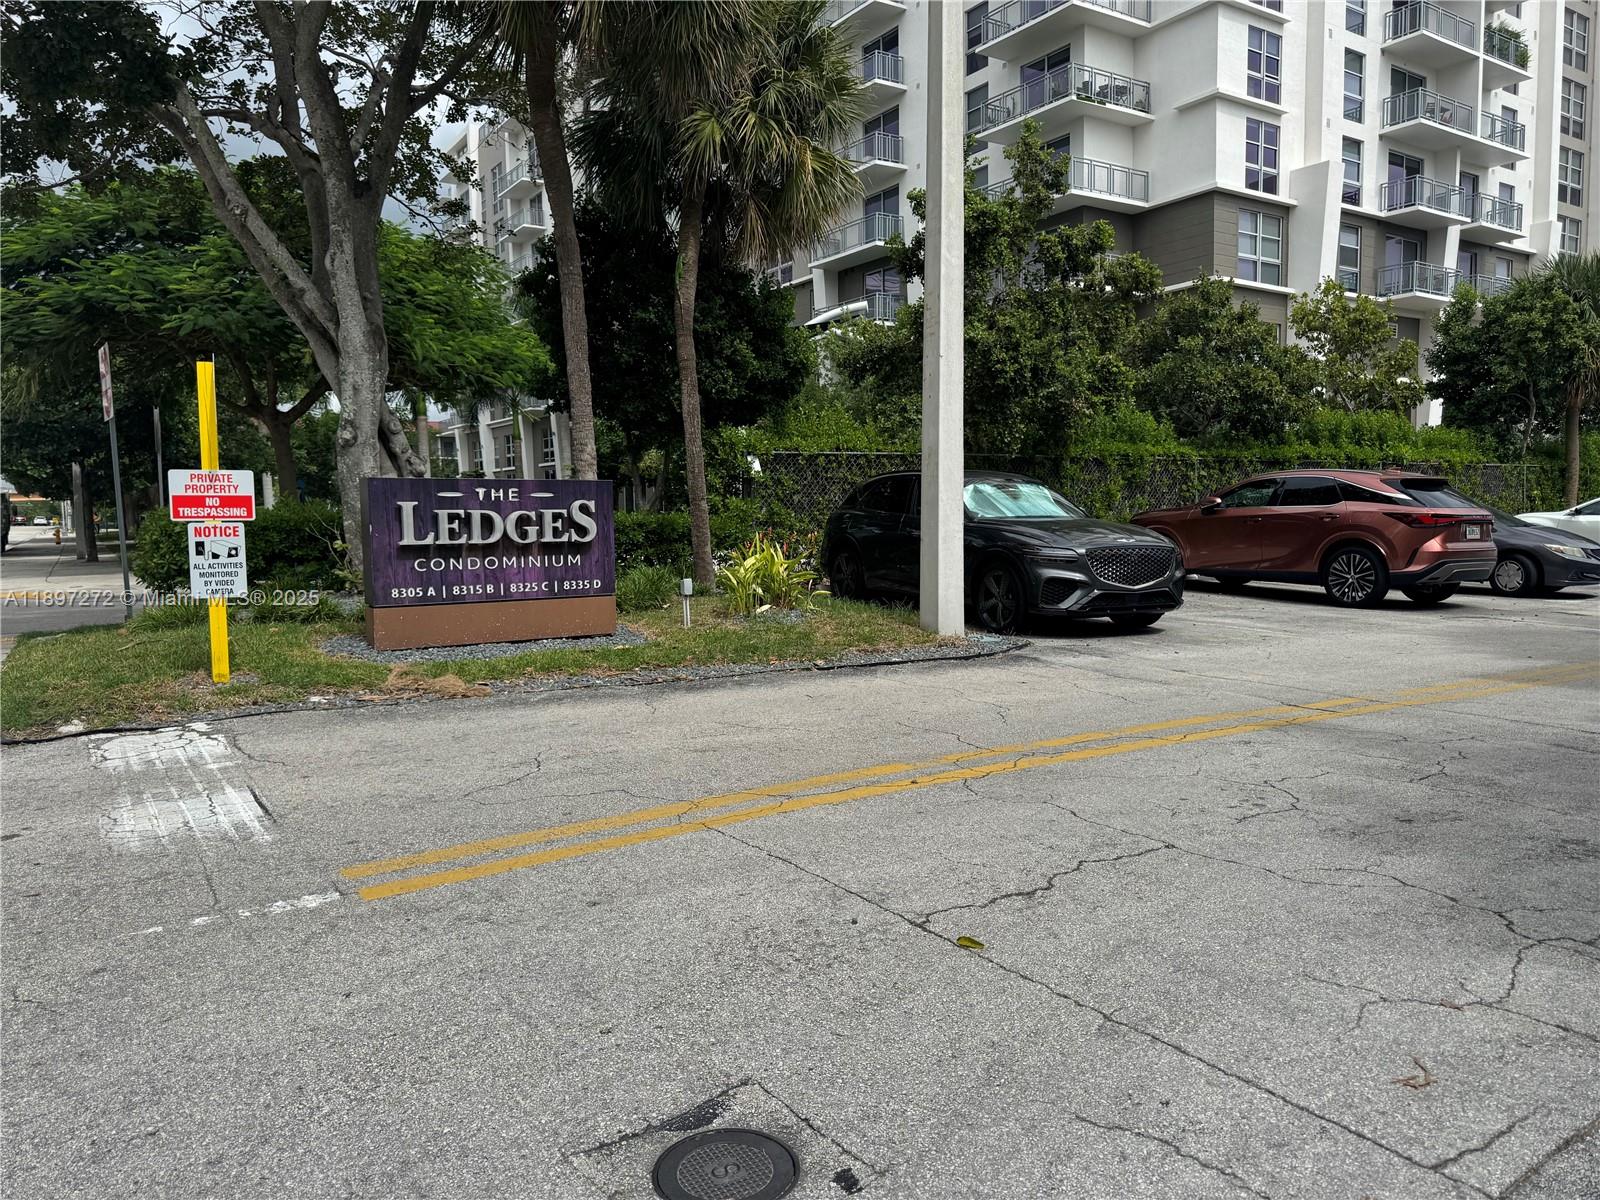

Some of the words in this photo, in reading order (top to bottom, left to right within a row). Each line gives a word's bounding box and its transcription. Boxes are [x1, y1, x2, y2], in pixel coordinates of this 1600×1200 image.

[190, 473, 233, 483] PRIVATE
[184, 484, 239, 494] PROPERTY
[475, 487, 520, 502] THE
[206, 497, 220, 506] NO
[178, 508, 248, 516] TRESPASSING
[194, 526, 240, 538] NOTICE
[414, 554, 582, 572] CONDOMINIUM
[391, 586, 424, 598] 8305
[427, 586, 436, 597] A
[452, 584, 483, 596] 8315
[486, 584, 494, 594] B
[510, 582, 538, 593] 8325
[541, 581, 549, 591] C
[563, 580, 590, 590] 8335
[594, 579, 601, 589] D
